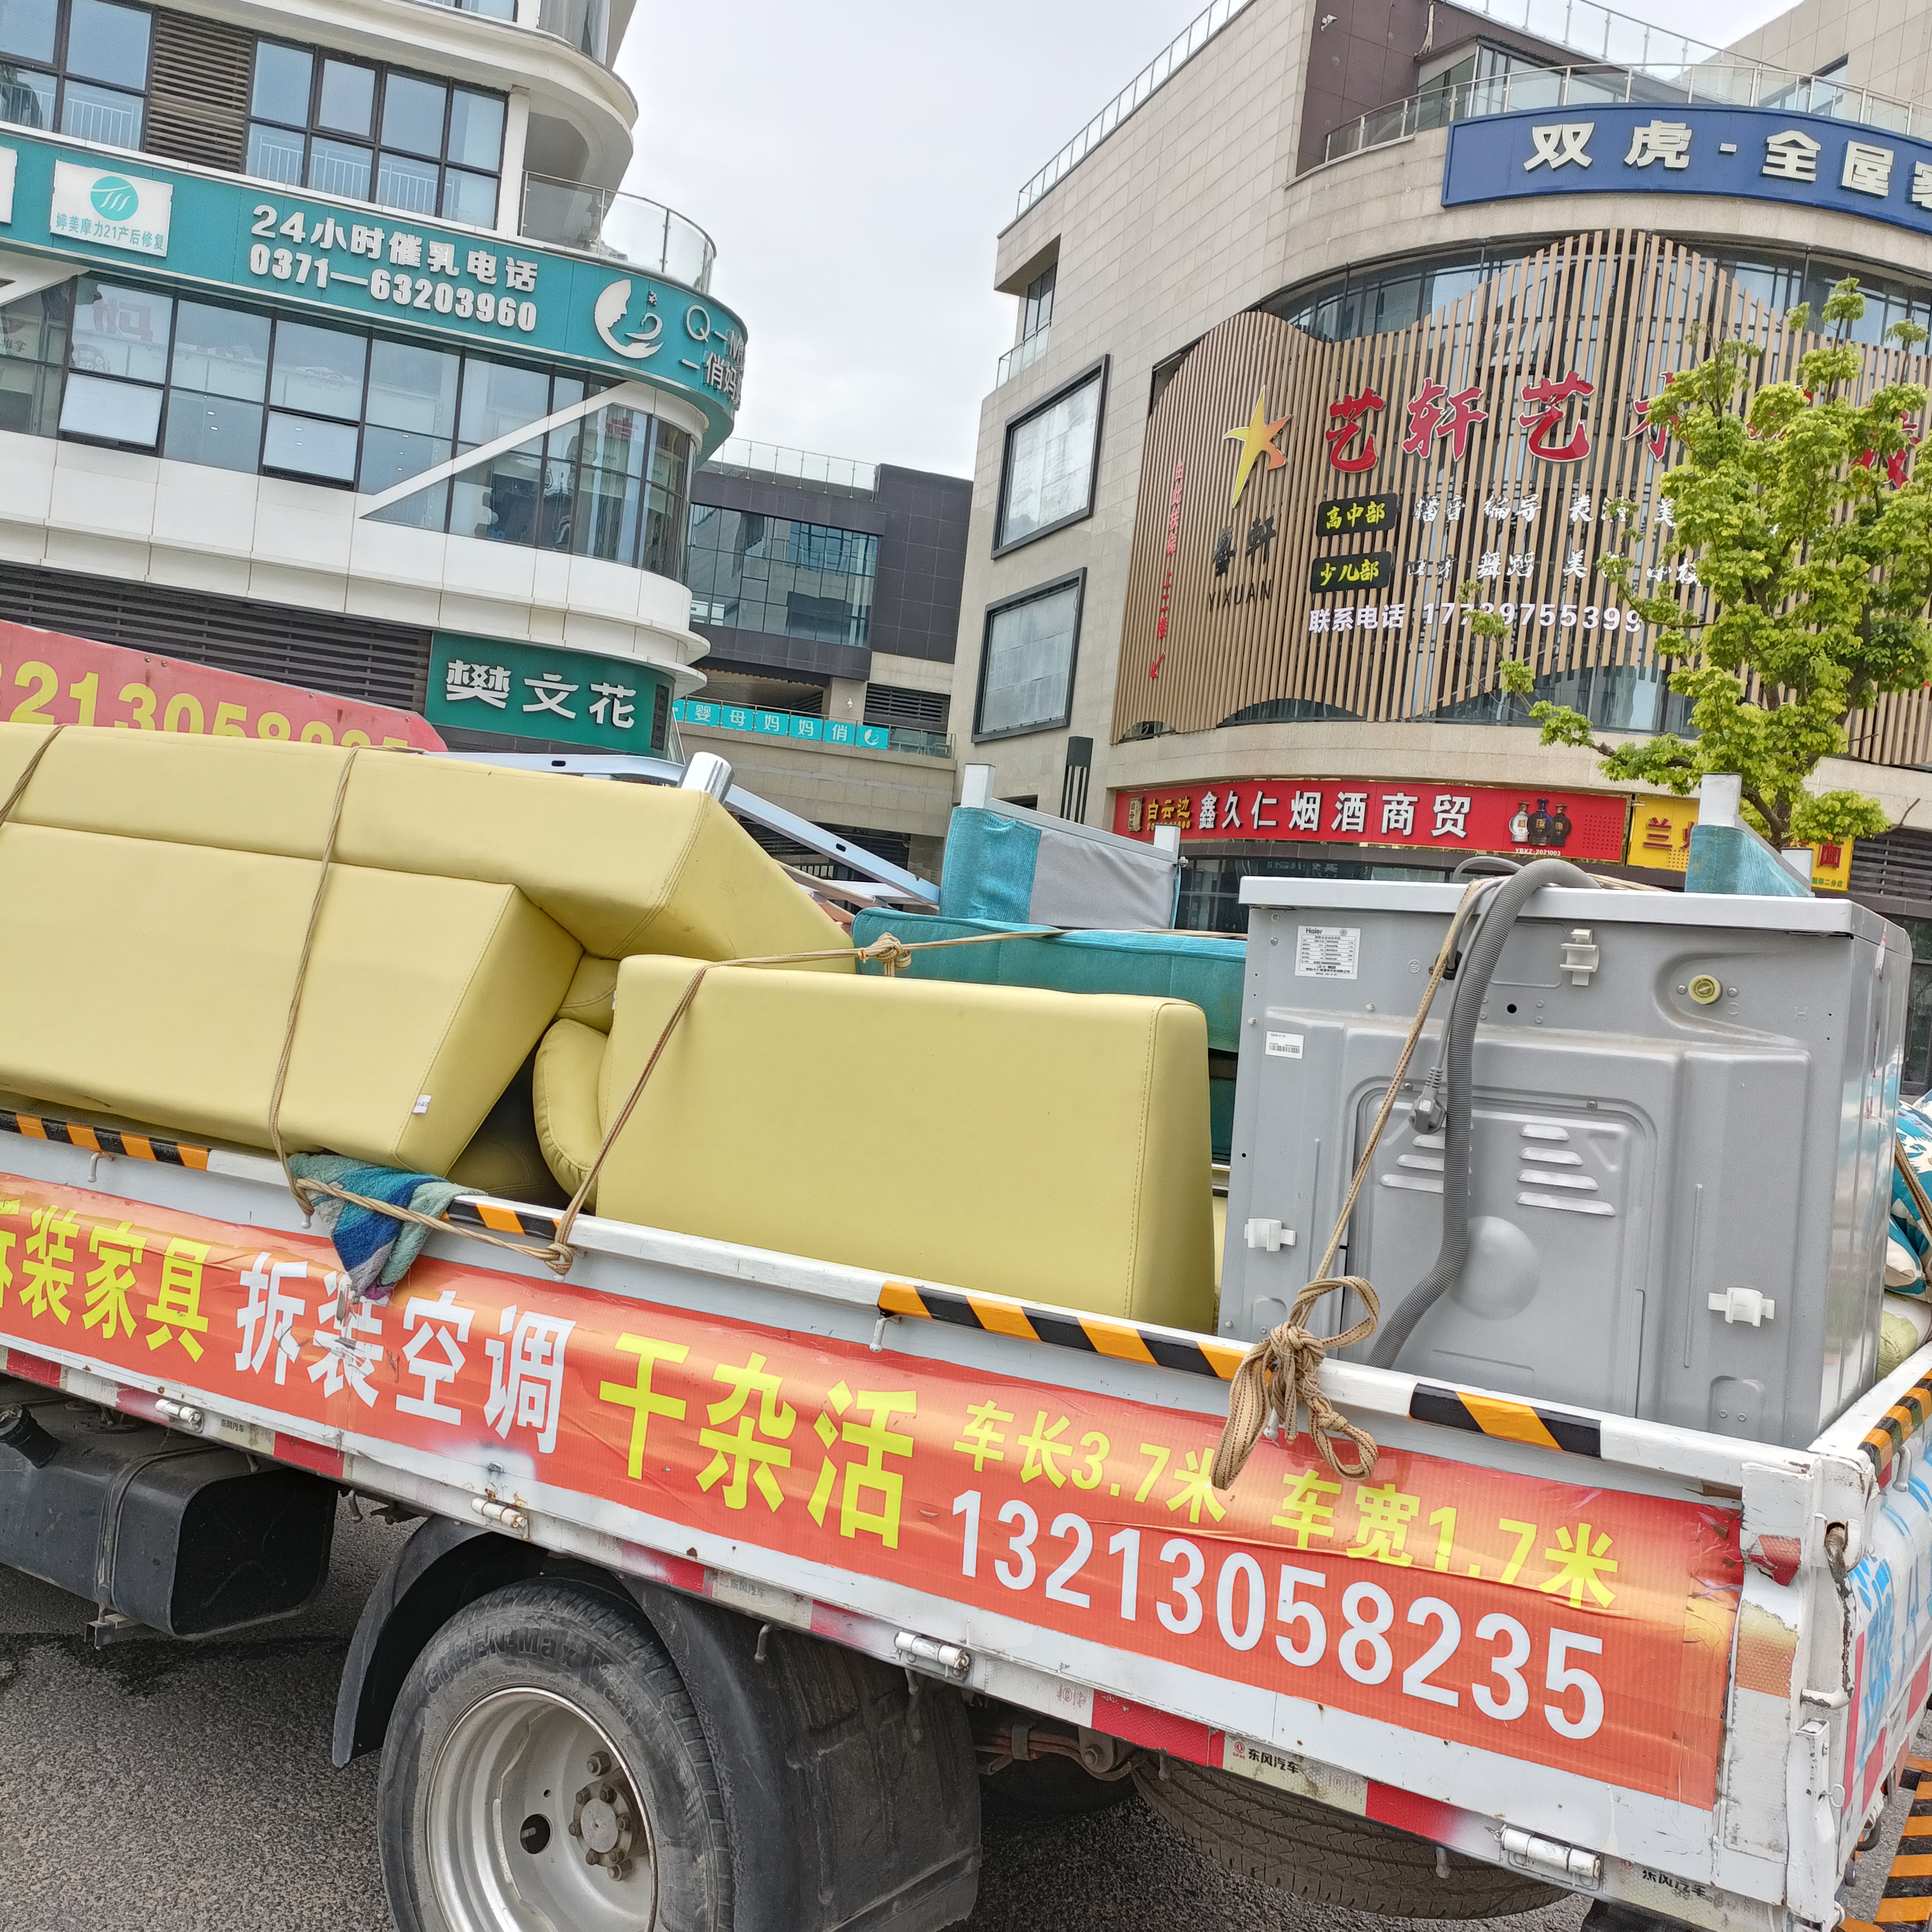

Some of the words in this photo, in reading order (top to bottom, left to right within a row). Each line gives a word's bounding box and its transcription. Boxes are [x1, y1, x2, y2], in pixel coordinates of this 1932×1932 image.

[56, 212, 165, 250] 婷美摩力21产后修复
[251, 204, 538, 293] 24小时催乳电话
[1326, 501, 1386, 529] 高中部
[1414, 492, 1466, 523] 播音
[1483, 492, 1542, 523] 编导
[1320, 558, 1380, 586] 少儿部
[1476, 549, 1535, 580] 舞蹈
[1208, 578, 1272, 612] YIXUAN
[1309, 603, 1406, 633] 联系电话
[446, 659, 637, 728] 樊文花
[1148, 796, 1191, 821] 白云边
[1198, 791, 1471, 838] 鑫久仁烟酒商贸
[235, 1251, 576, 1454] 拆装空调
[599, 1332, 918, 1549] 干杂活
[953, 1399, 1227, 1524] 车长3.7米
[1271, 1468, 1618, 1609] 车宽1.7米
[952, 1489, 1604, 1740] 13213058235
[1248, 1748, 1299, 1774] 东风汽车
